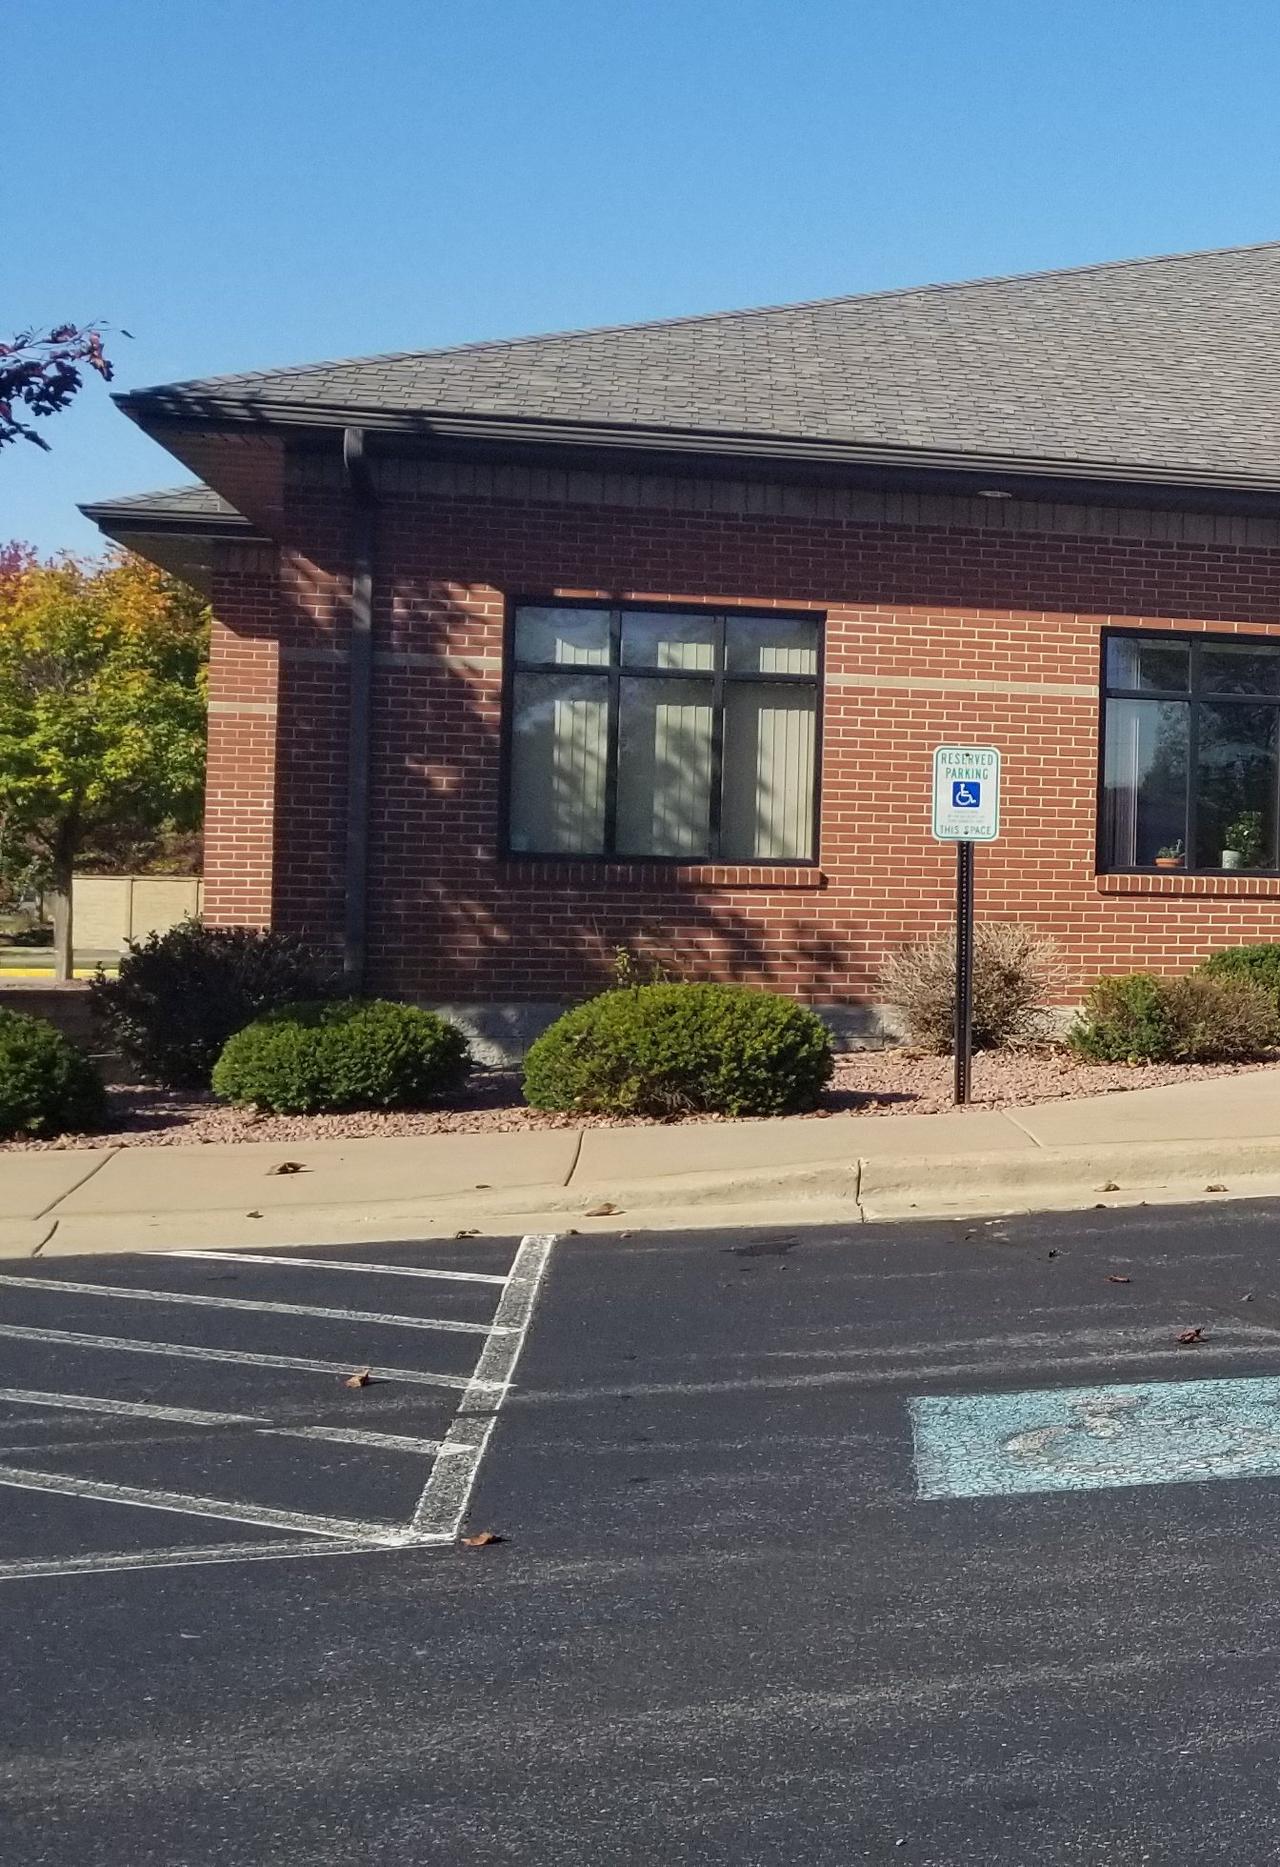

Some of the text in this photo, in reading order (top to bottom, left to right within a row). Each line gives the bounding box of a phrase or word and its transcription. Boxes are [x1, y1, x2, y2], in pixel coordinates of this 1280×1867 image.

[941, 752, 994, 766] RESERVED
[945, 767, 989, 780] PARKING
[940, 825, 992, 835] THIS SPACE
